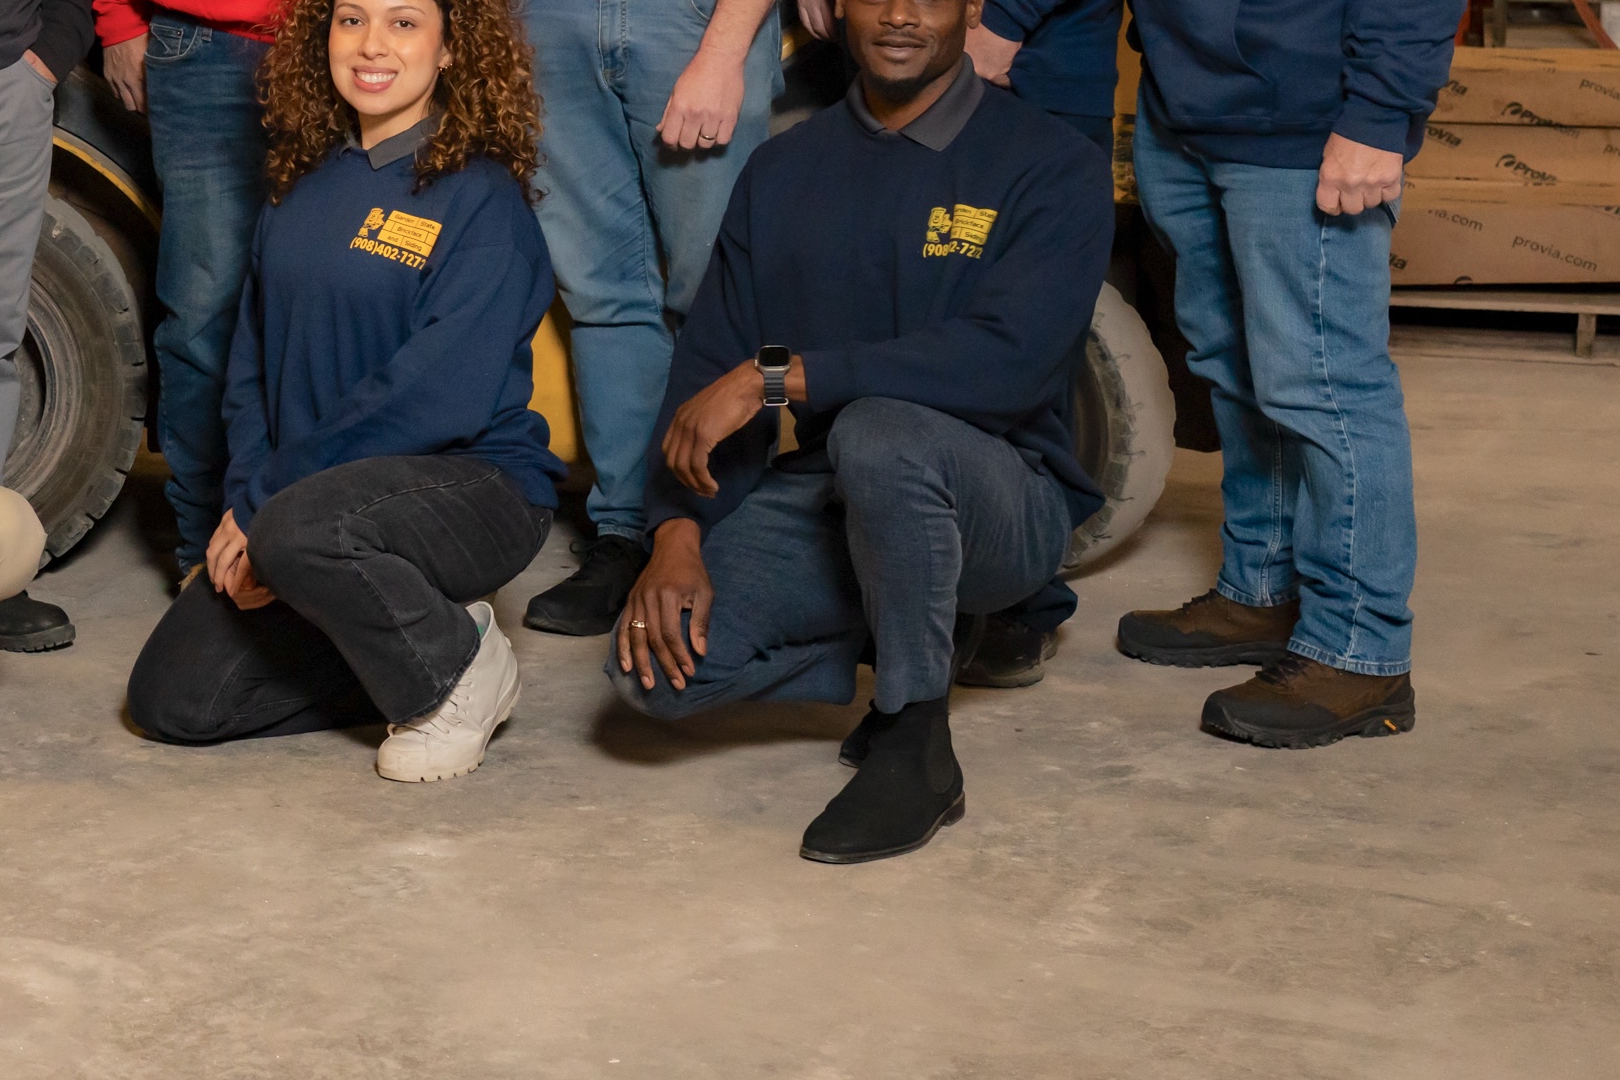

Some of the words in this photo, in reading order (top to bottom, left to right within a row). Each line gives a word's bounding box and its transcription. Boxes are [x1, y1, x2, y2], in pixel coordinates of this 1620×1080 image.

[395, 214, 415, 223] Garden
[421, 221, 436, 230] State
[397, 227, 422, 238] Brickface
[405, 241, 423, 252] Siding
[1512, 235, 1598, 271] provia.com
